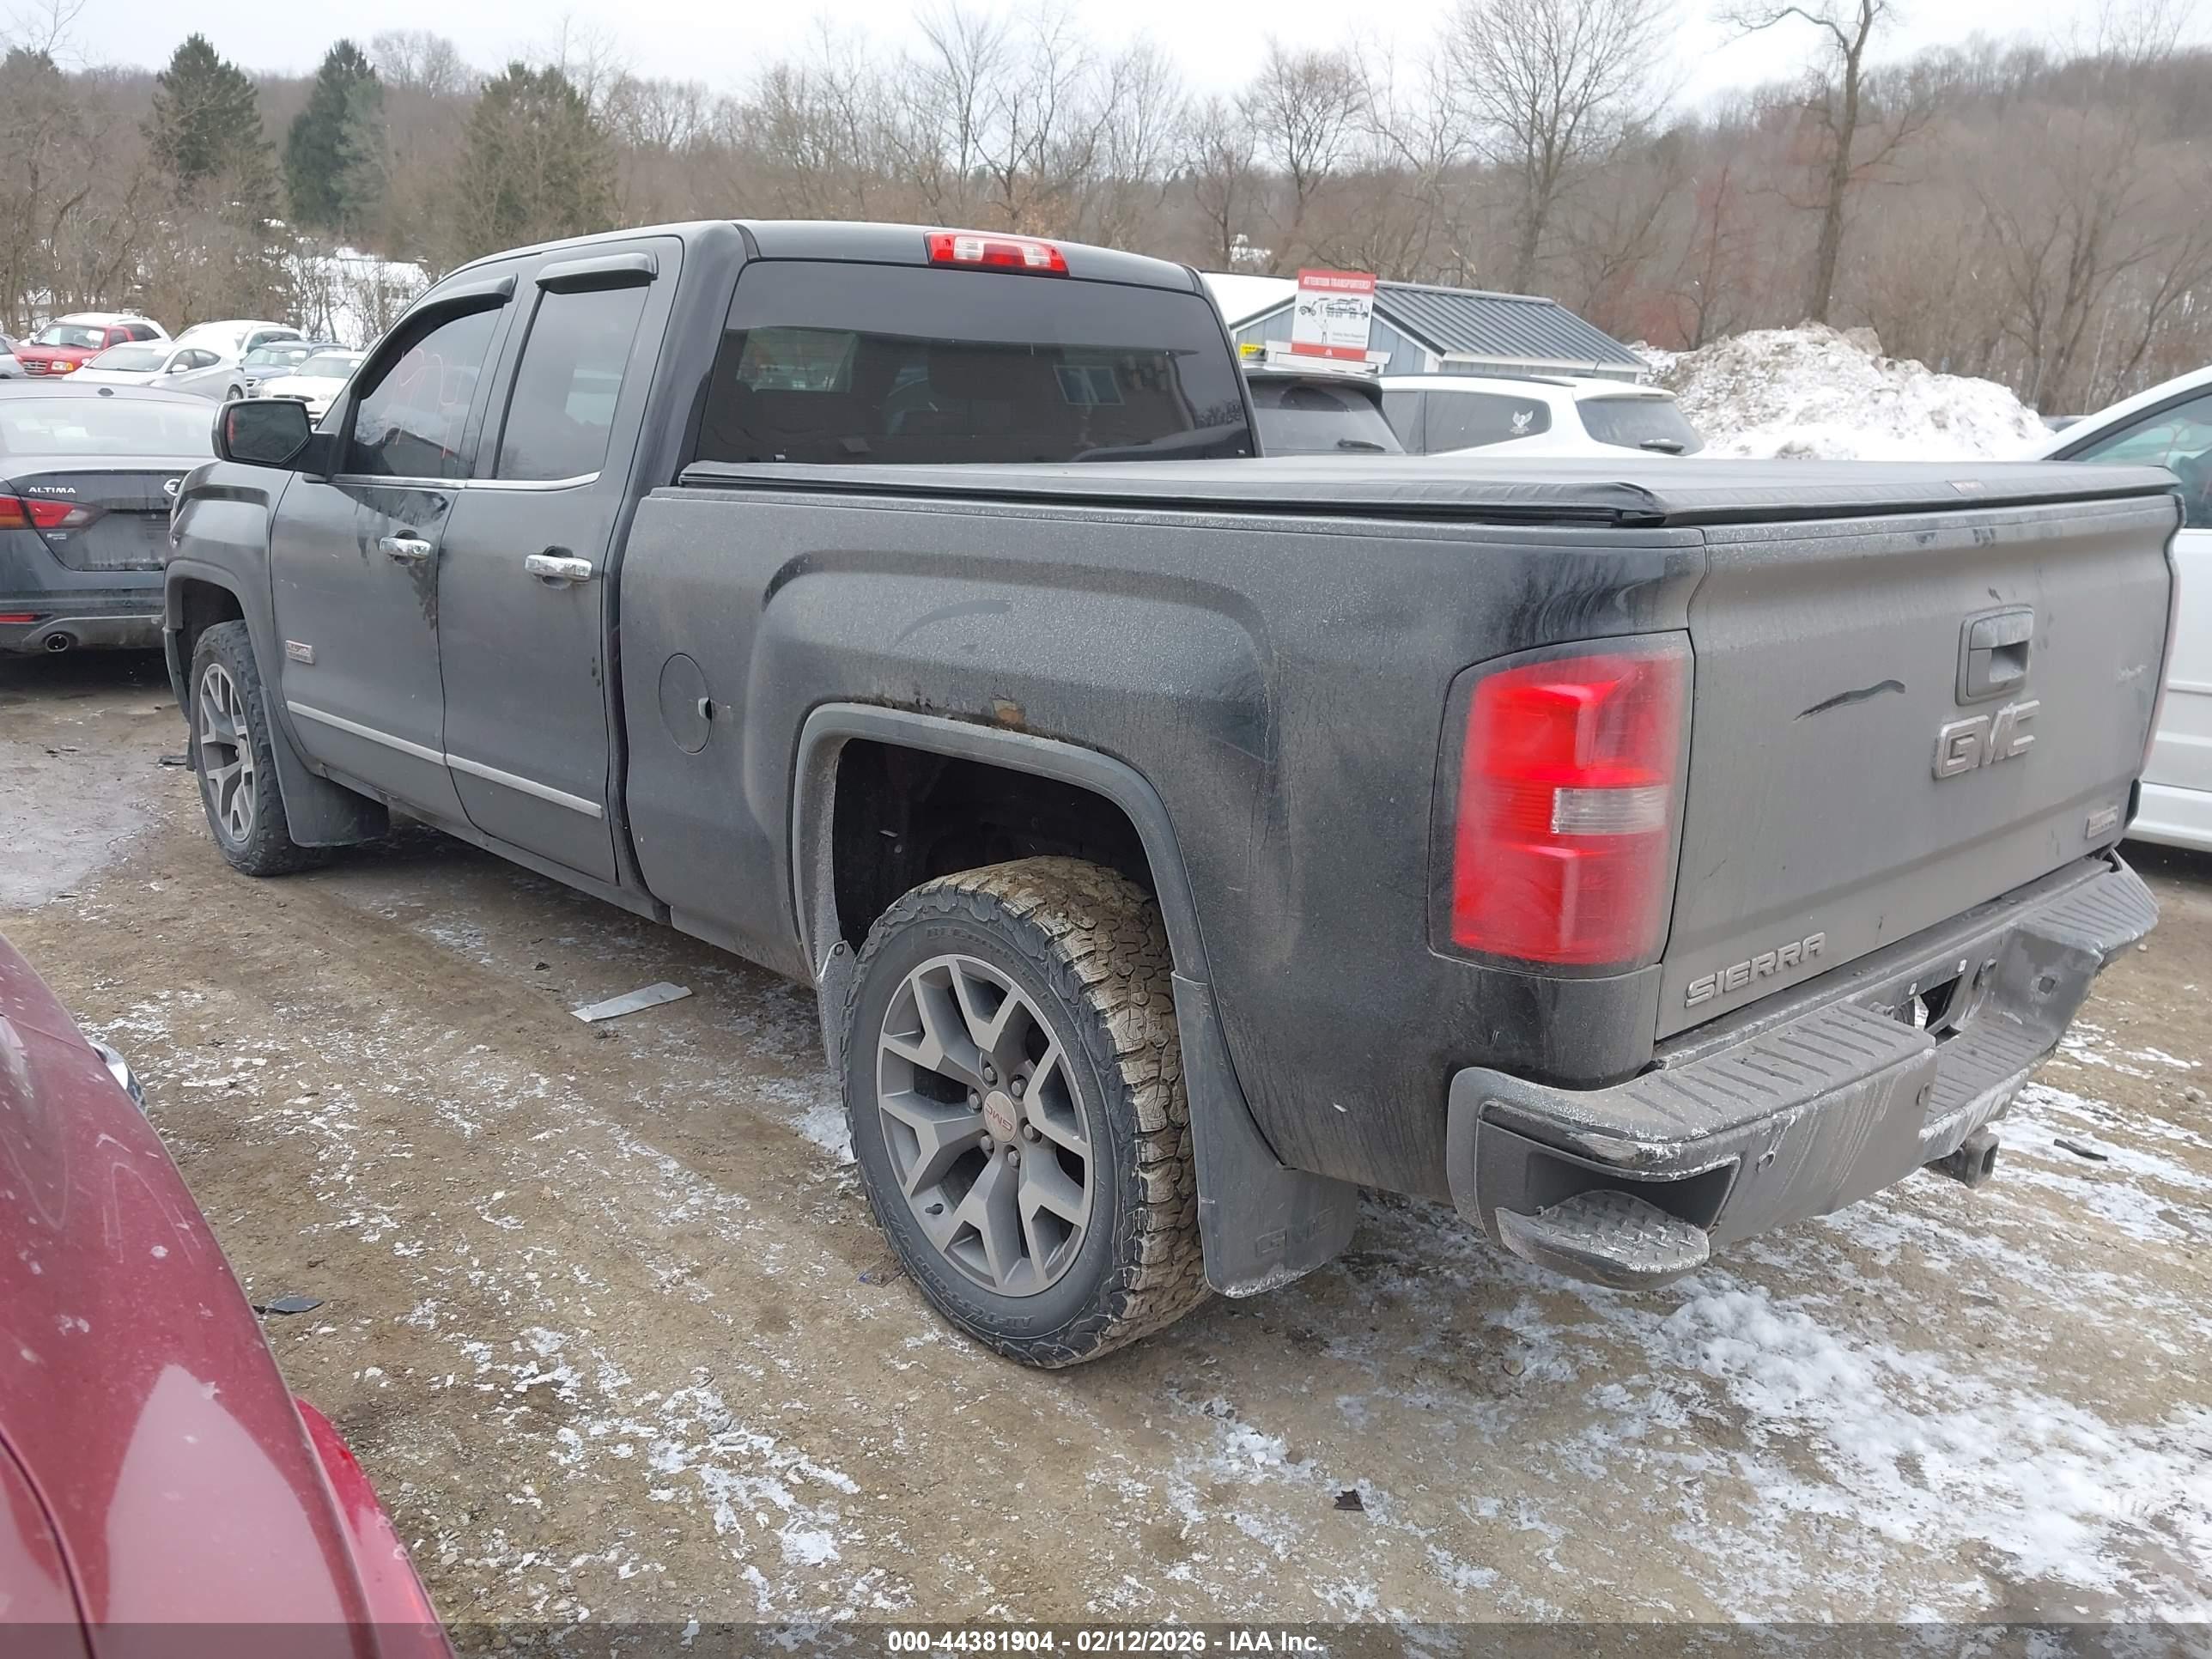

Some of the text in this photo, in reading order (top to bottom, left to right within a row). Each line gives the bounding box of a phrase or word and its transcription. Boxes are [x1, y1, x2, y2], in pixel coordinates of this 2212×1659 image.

[1937, 700, 2040, 778] GMC
[1685, 932, 1826, 1008] SIERRA
[985, 1101, 1013, 1132] GMC
